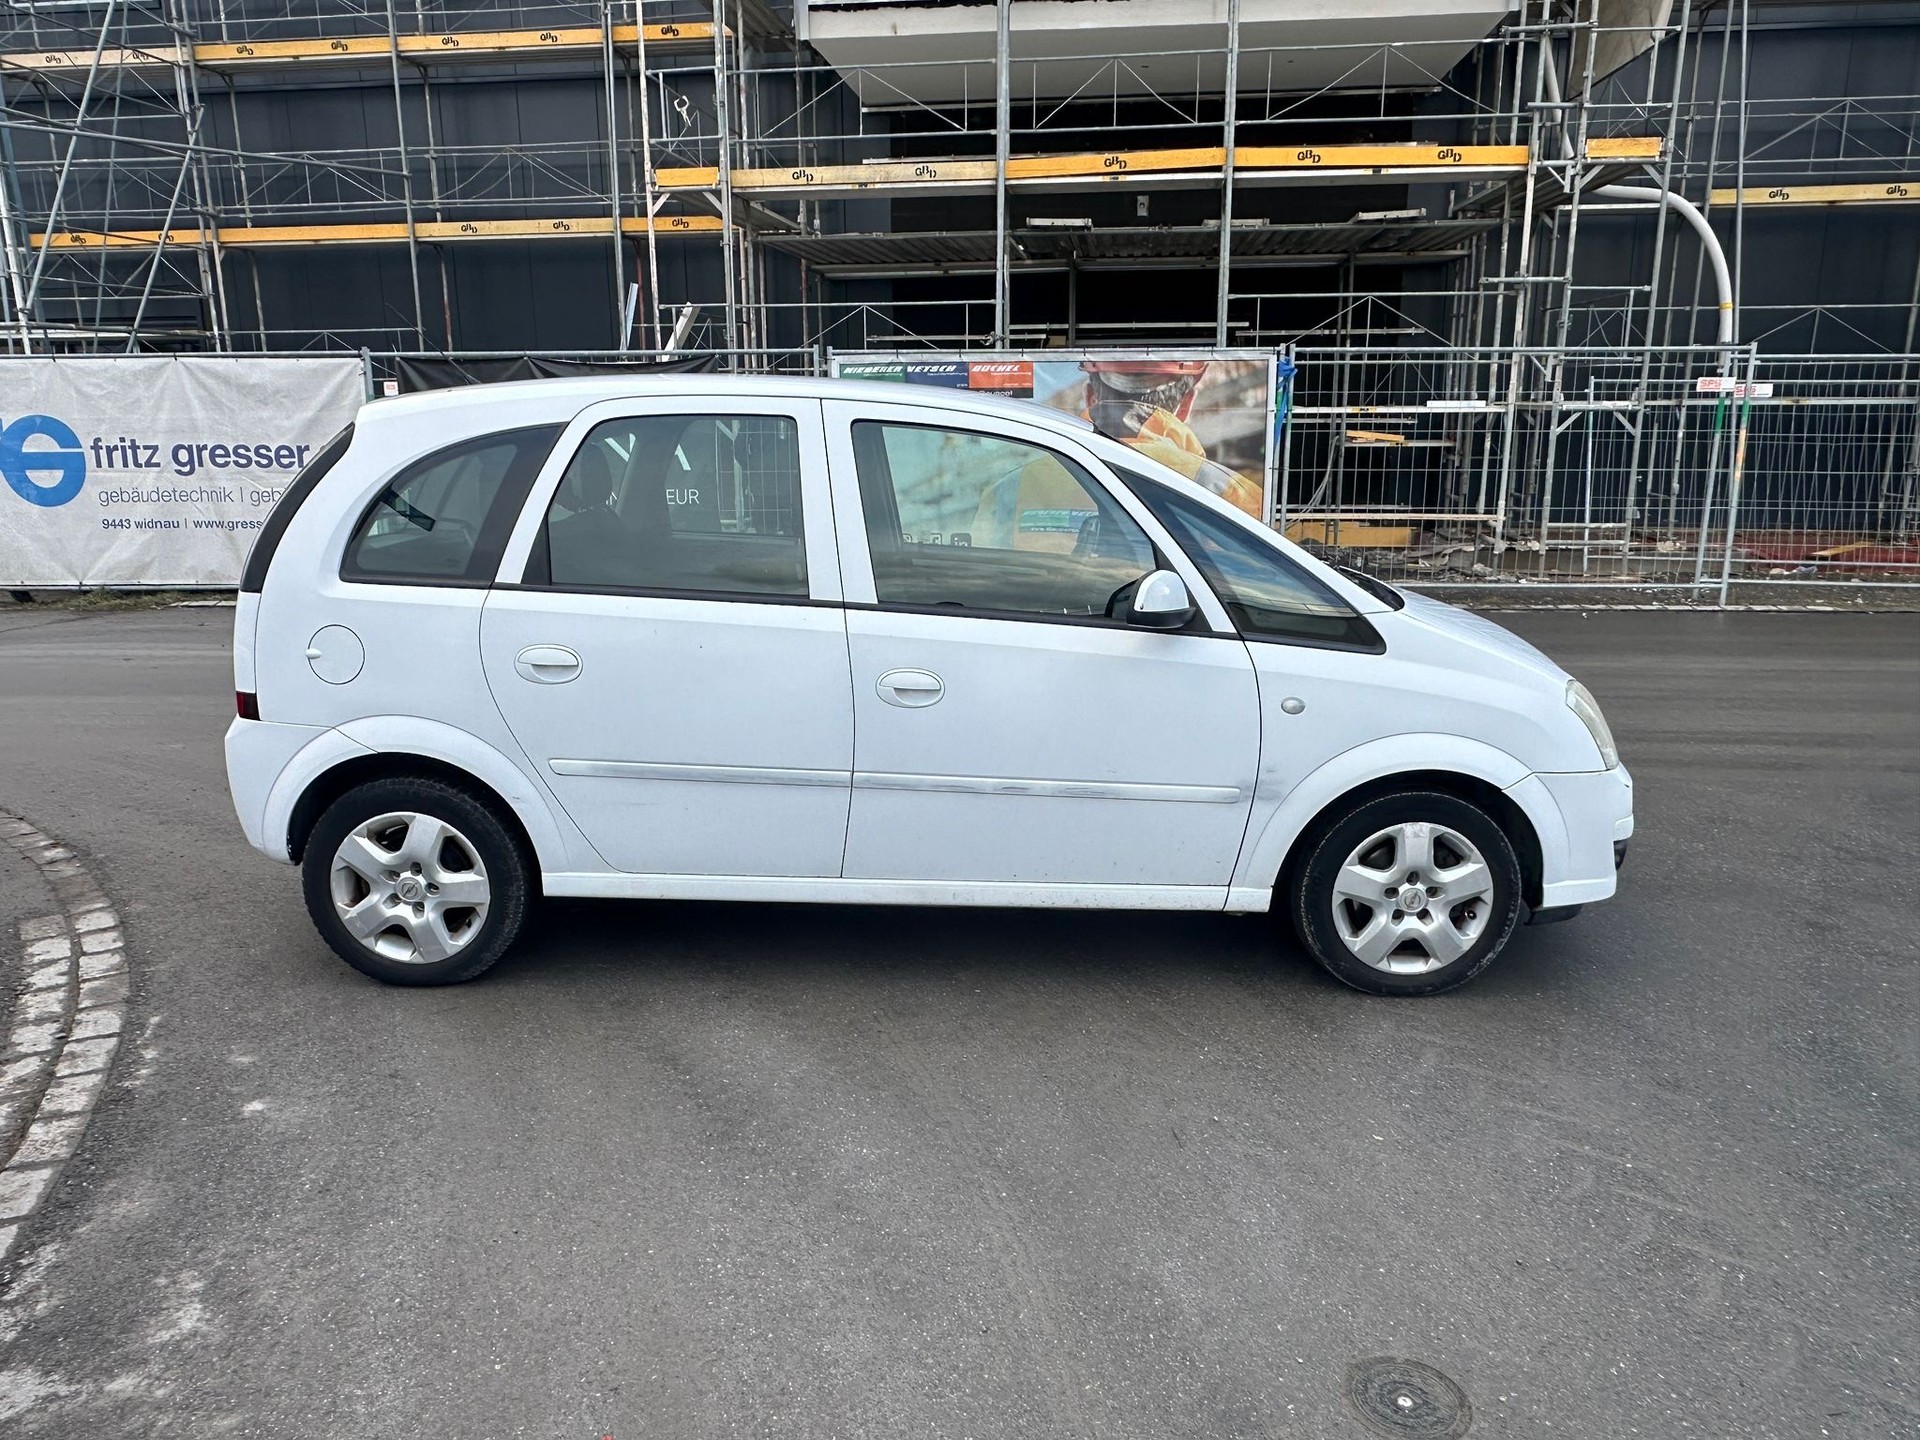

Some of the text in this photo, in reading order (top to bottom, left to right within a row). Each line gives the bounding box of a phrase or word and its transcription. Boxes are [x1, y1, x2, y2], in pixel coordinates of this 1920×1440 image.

[661, 25, 679, 36] GBD
[441, 37, 459, 47] GBD
[540, 32, 557, 42] GBD
[1297, 150, 1321, 163] GBD
[1437, 149, 1462, 162] GBD
[1104, 156, 1127, 169] GBD
[792, 169, 814, 182] GBD
[915, 165, 937, 178] GBD
[461, 223, 478, 233] GBD
[553, 221, 570, 231] GBD
[672, 218, 689, 228] GBD
[90, 436, 310, 476] fritz gresser
[98, 486, 287, 507] gebäudetechnik geb
[102, 518, 131, 530] 9443
[134, 518, 180, 530] widnau
